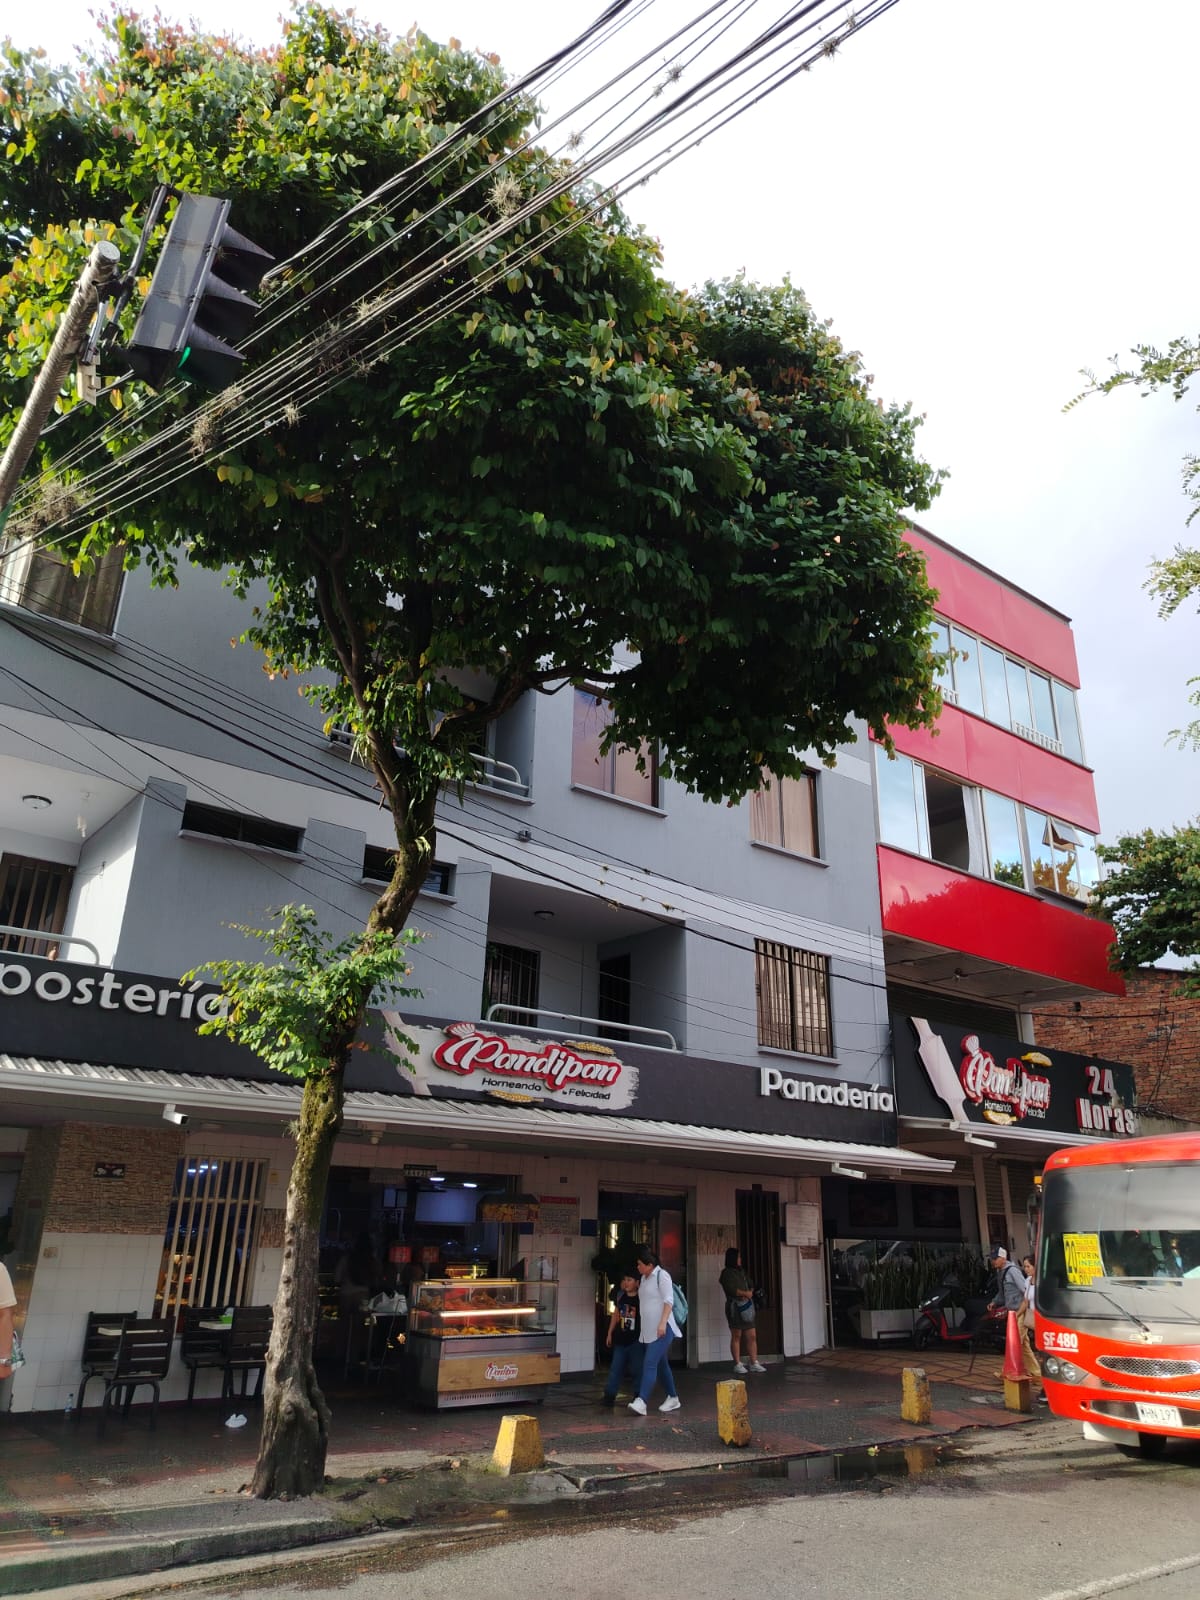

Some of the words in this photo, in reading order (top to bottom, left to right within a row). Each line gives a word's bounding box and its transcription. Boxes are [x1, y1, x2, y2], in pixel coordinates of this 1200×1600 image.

[440, 1034, 620, 1087] Pandipan
[481, 1077, 542, 1092] Horneando
[568, 1088, 611, 1100] Felicidad
[760, 1067, 893, 1112] Panadería
[1086, 1065, 1116, 1096] 24
[1078, 1097, 1134, 1134] Horas
[1065, 1240, 1078, 1274] 20
[1043, 1331, 1056, 1346] SF
[1057, 1332, 1079, 1348] 480
